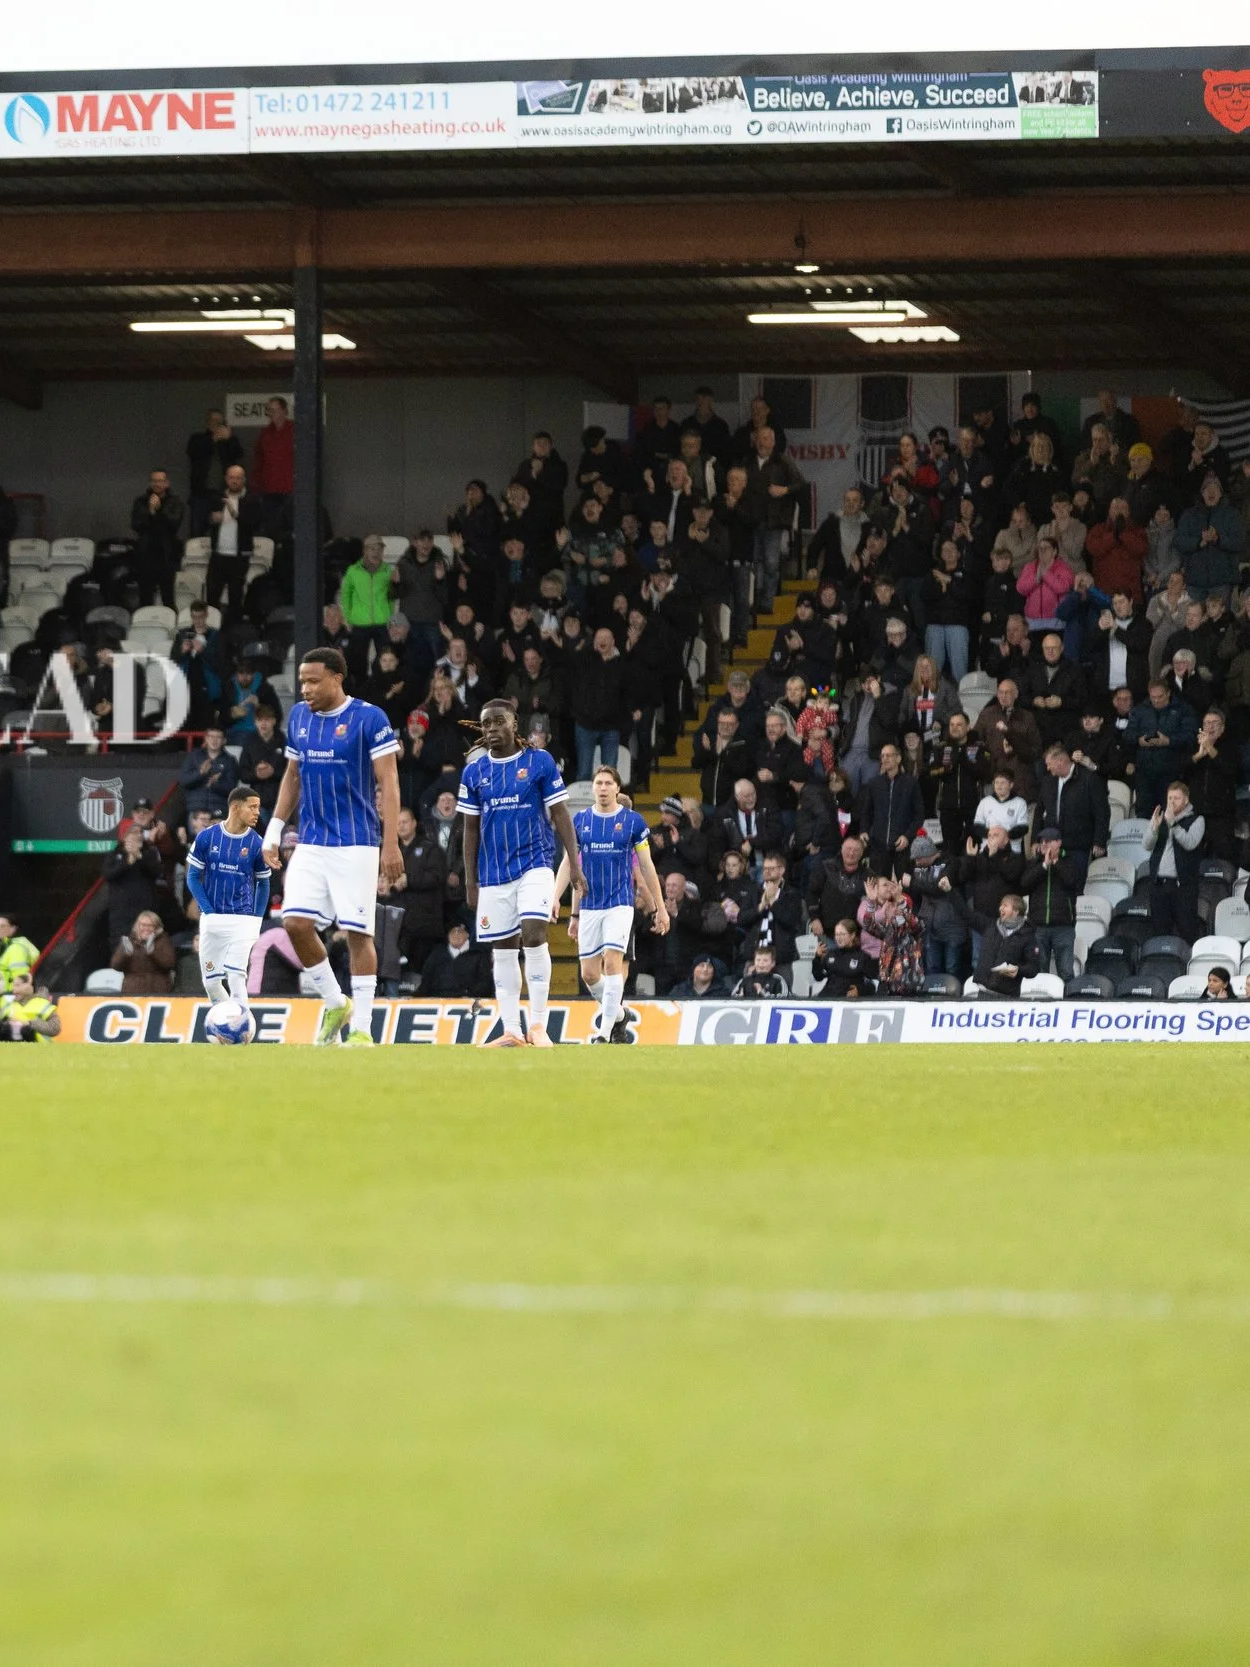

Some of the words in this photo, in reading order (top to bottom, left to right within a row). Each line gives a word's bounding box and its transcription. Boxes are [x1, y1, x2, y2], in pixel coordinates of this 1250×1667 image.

[295, 92, 364, 113] 01472
[370, 90, 450, 111] 241211
[753, 86, 831, 110] Believe,
[836, 85, 919, 109] Achieve,
[925, 83, 1010, 107] Succeed
[56, 92, 236, 133] MAYNE
[254, 117, 507, 139] www.maynegasheating.co.uk
[521, 122, 733, 138] www.oasisacademywintringham.org
[767, 118, 872, 133] @OAWintringham
[906, 117, 1016, 132] OasisWintringham
[84, 135, 136, 149] HEATING
[139, 135, 162, 148] LTD
[307, 749, 334, 758] Brunel
[87, 840, 114, 852] EXIT
[87, 1002, 291, 1043] CLE
[700, 1007, 895, 1043] GRF
[931, 1007, 1060, 1029] Industrial
[1071, 1008, 1186, 1036] Flooring
[1196, 1010, 1250, 1036] Spe
